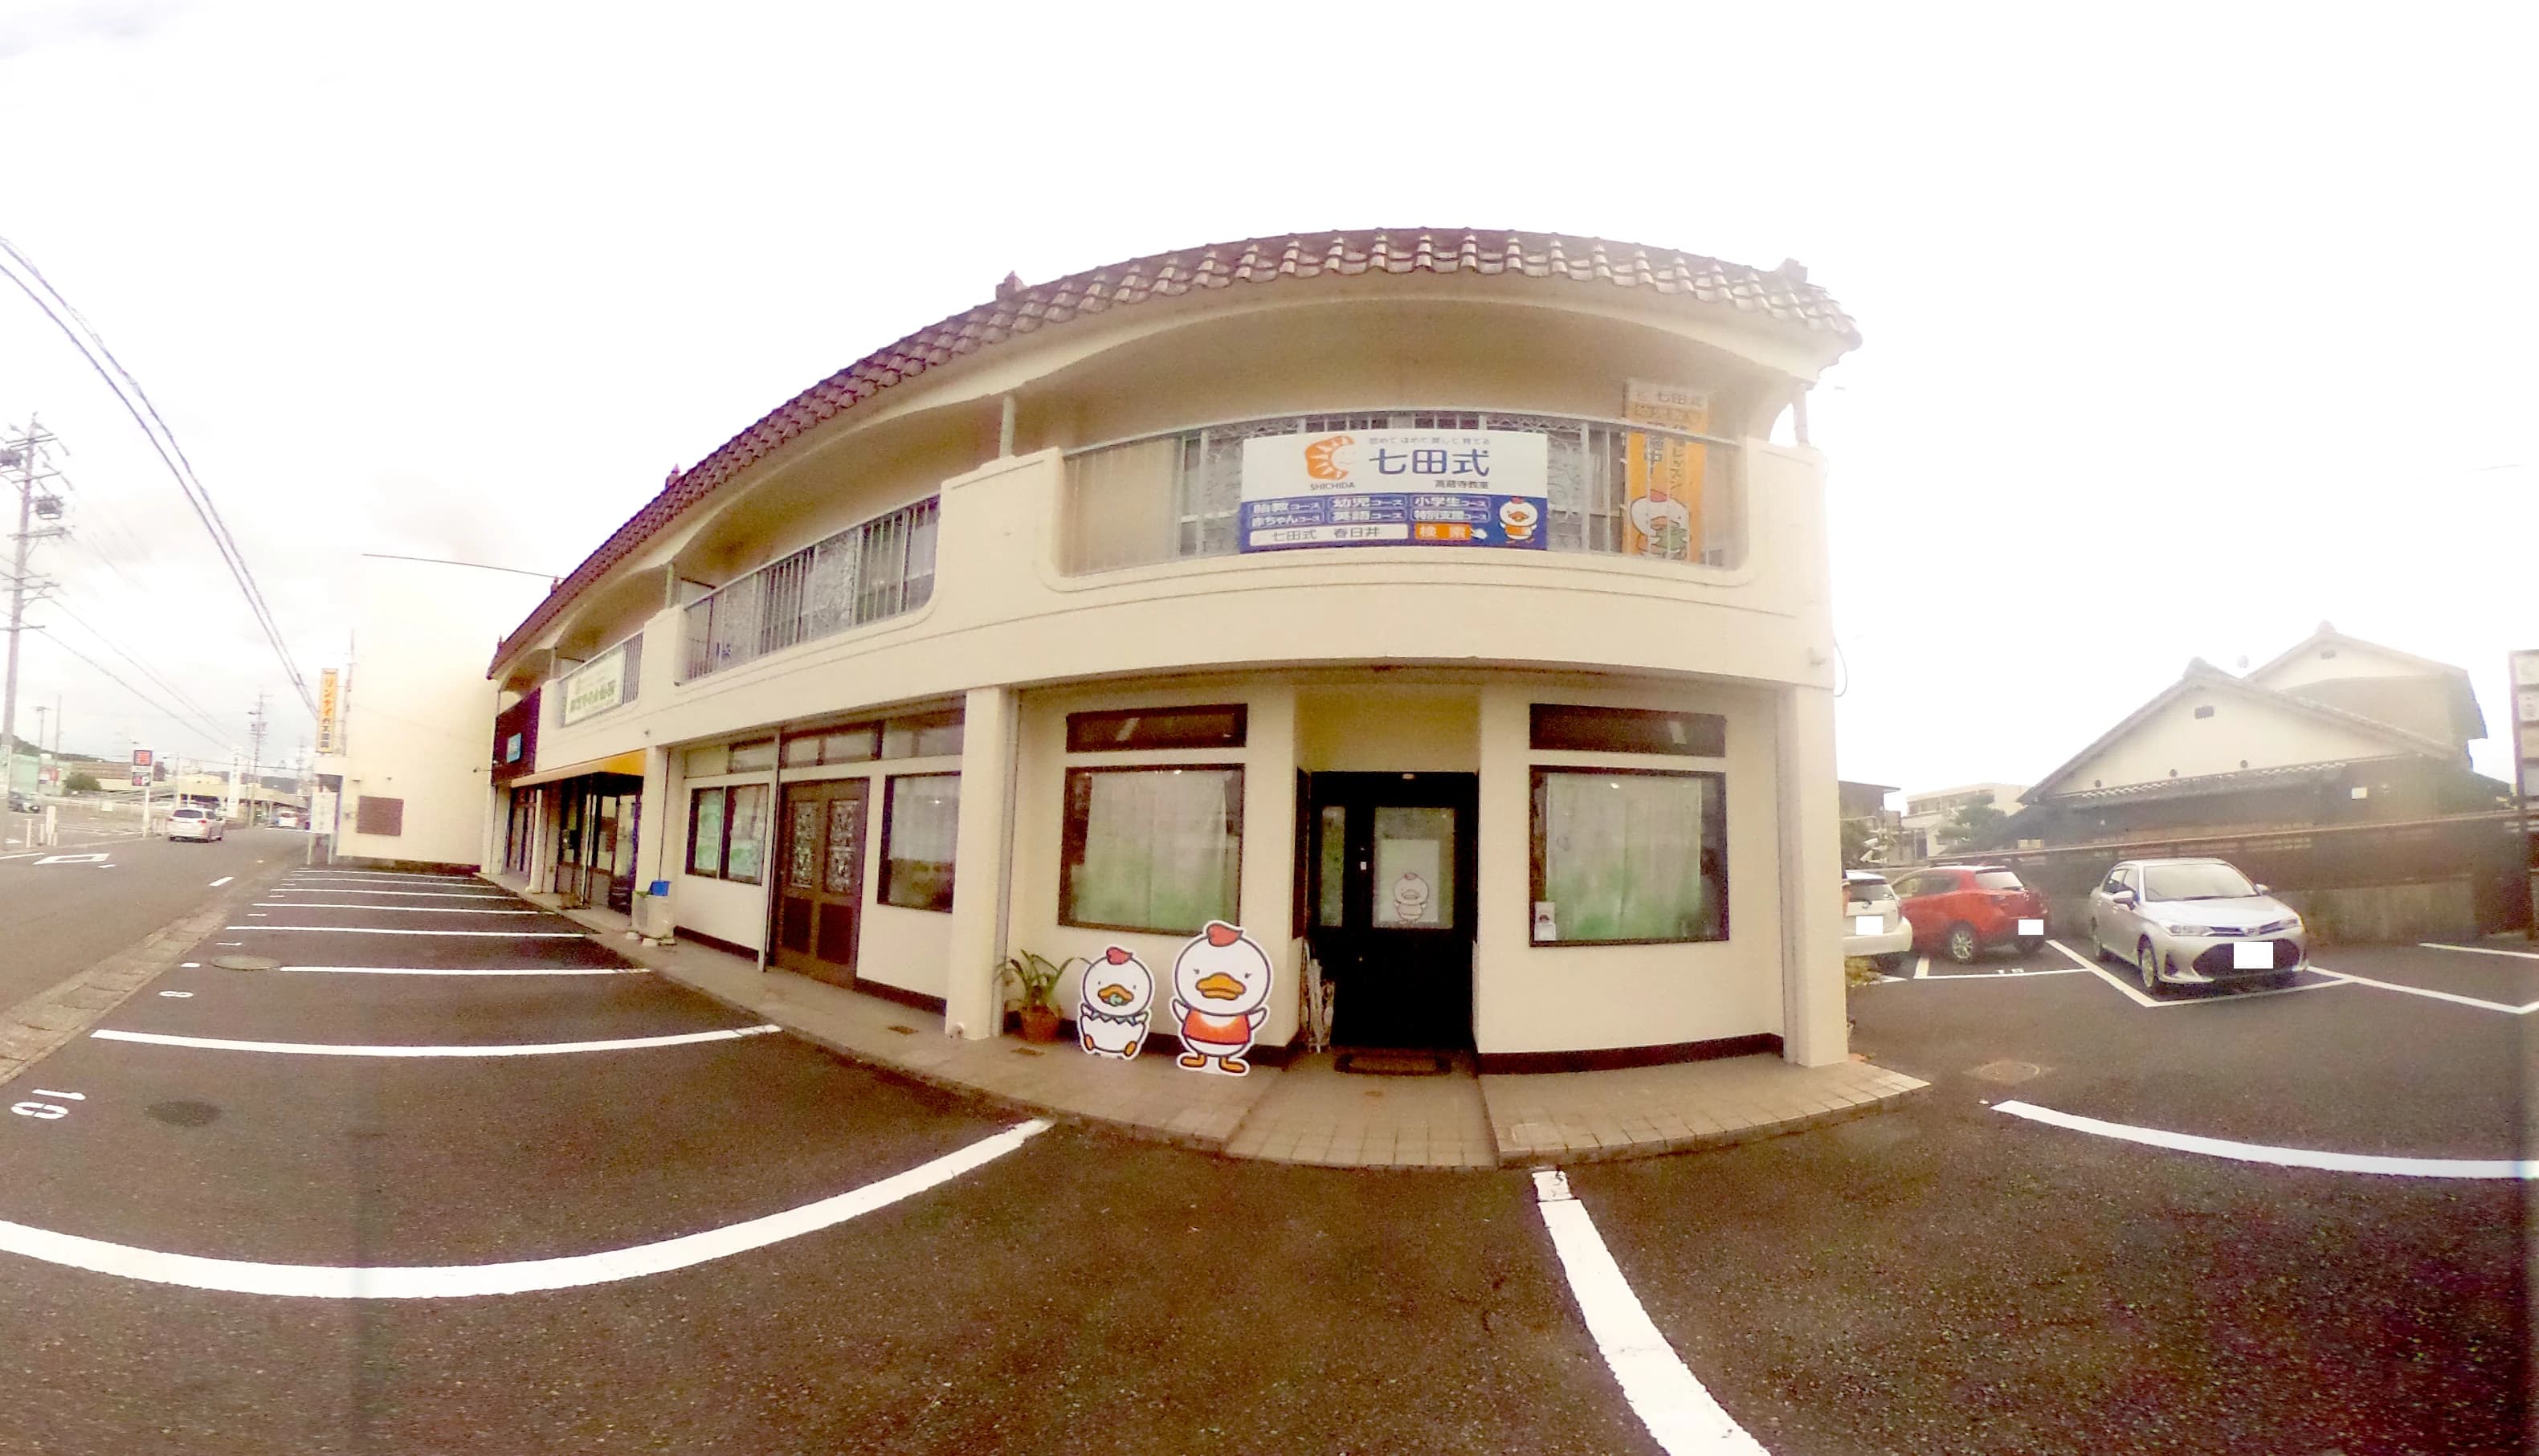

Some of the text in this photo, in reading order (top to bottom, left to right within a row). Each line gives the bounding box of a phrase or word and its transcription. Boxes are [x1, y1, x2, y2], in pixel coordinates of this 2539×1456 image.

[1369, 448, 1490, 477] 七田式
[1310, 482, 1355, 491] SHICHIDA
[1435, 479, 1490, 489] 高蔵寺教室
[1333, 496, 1403, 508] 幼児コース
[1414, 496, 1486, 507] 小学生コース
[1251, 515, 1321, 527] 赤ちゃんコース
[1272, 526, 1380, 541] 七田式 春日井
[158, 990, 194, 998] 8
